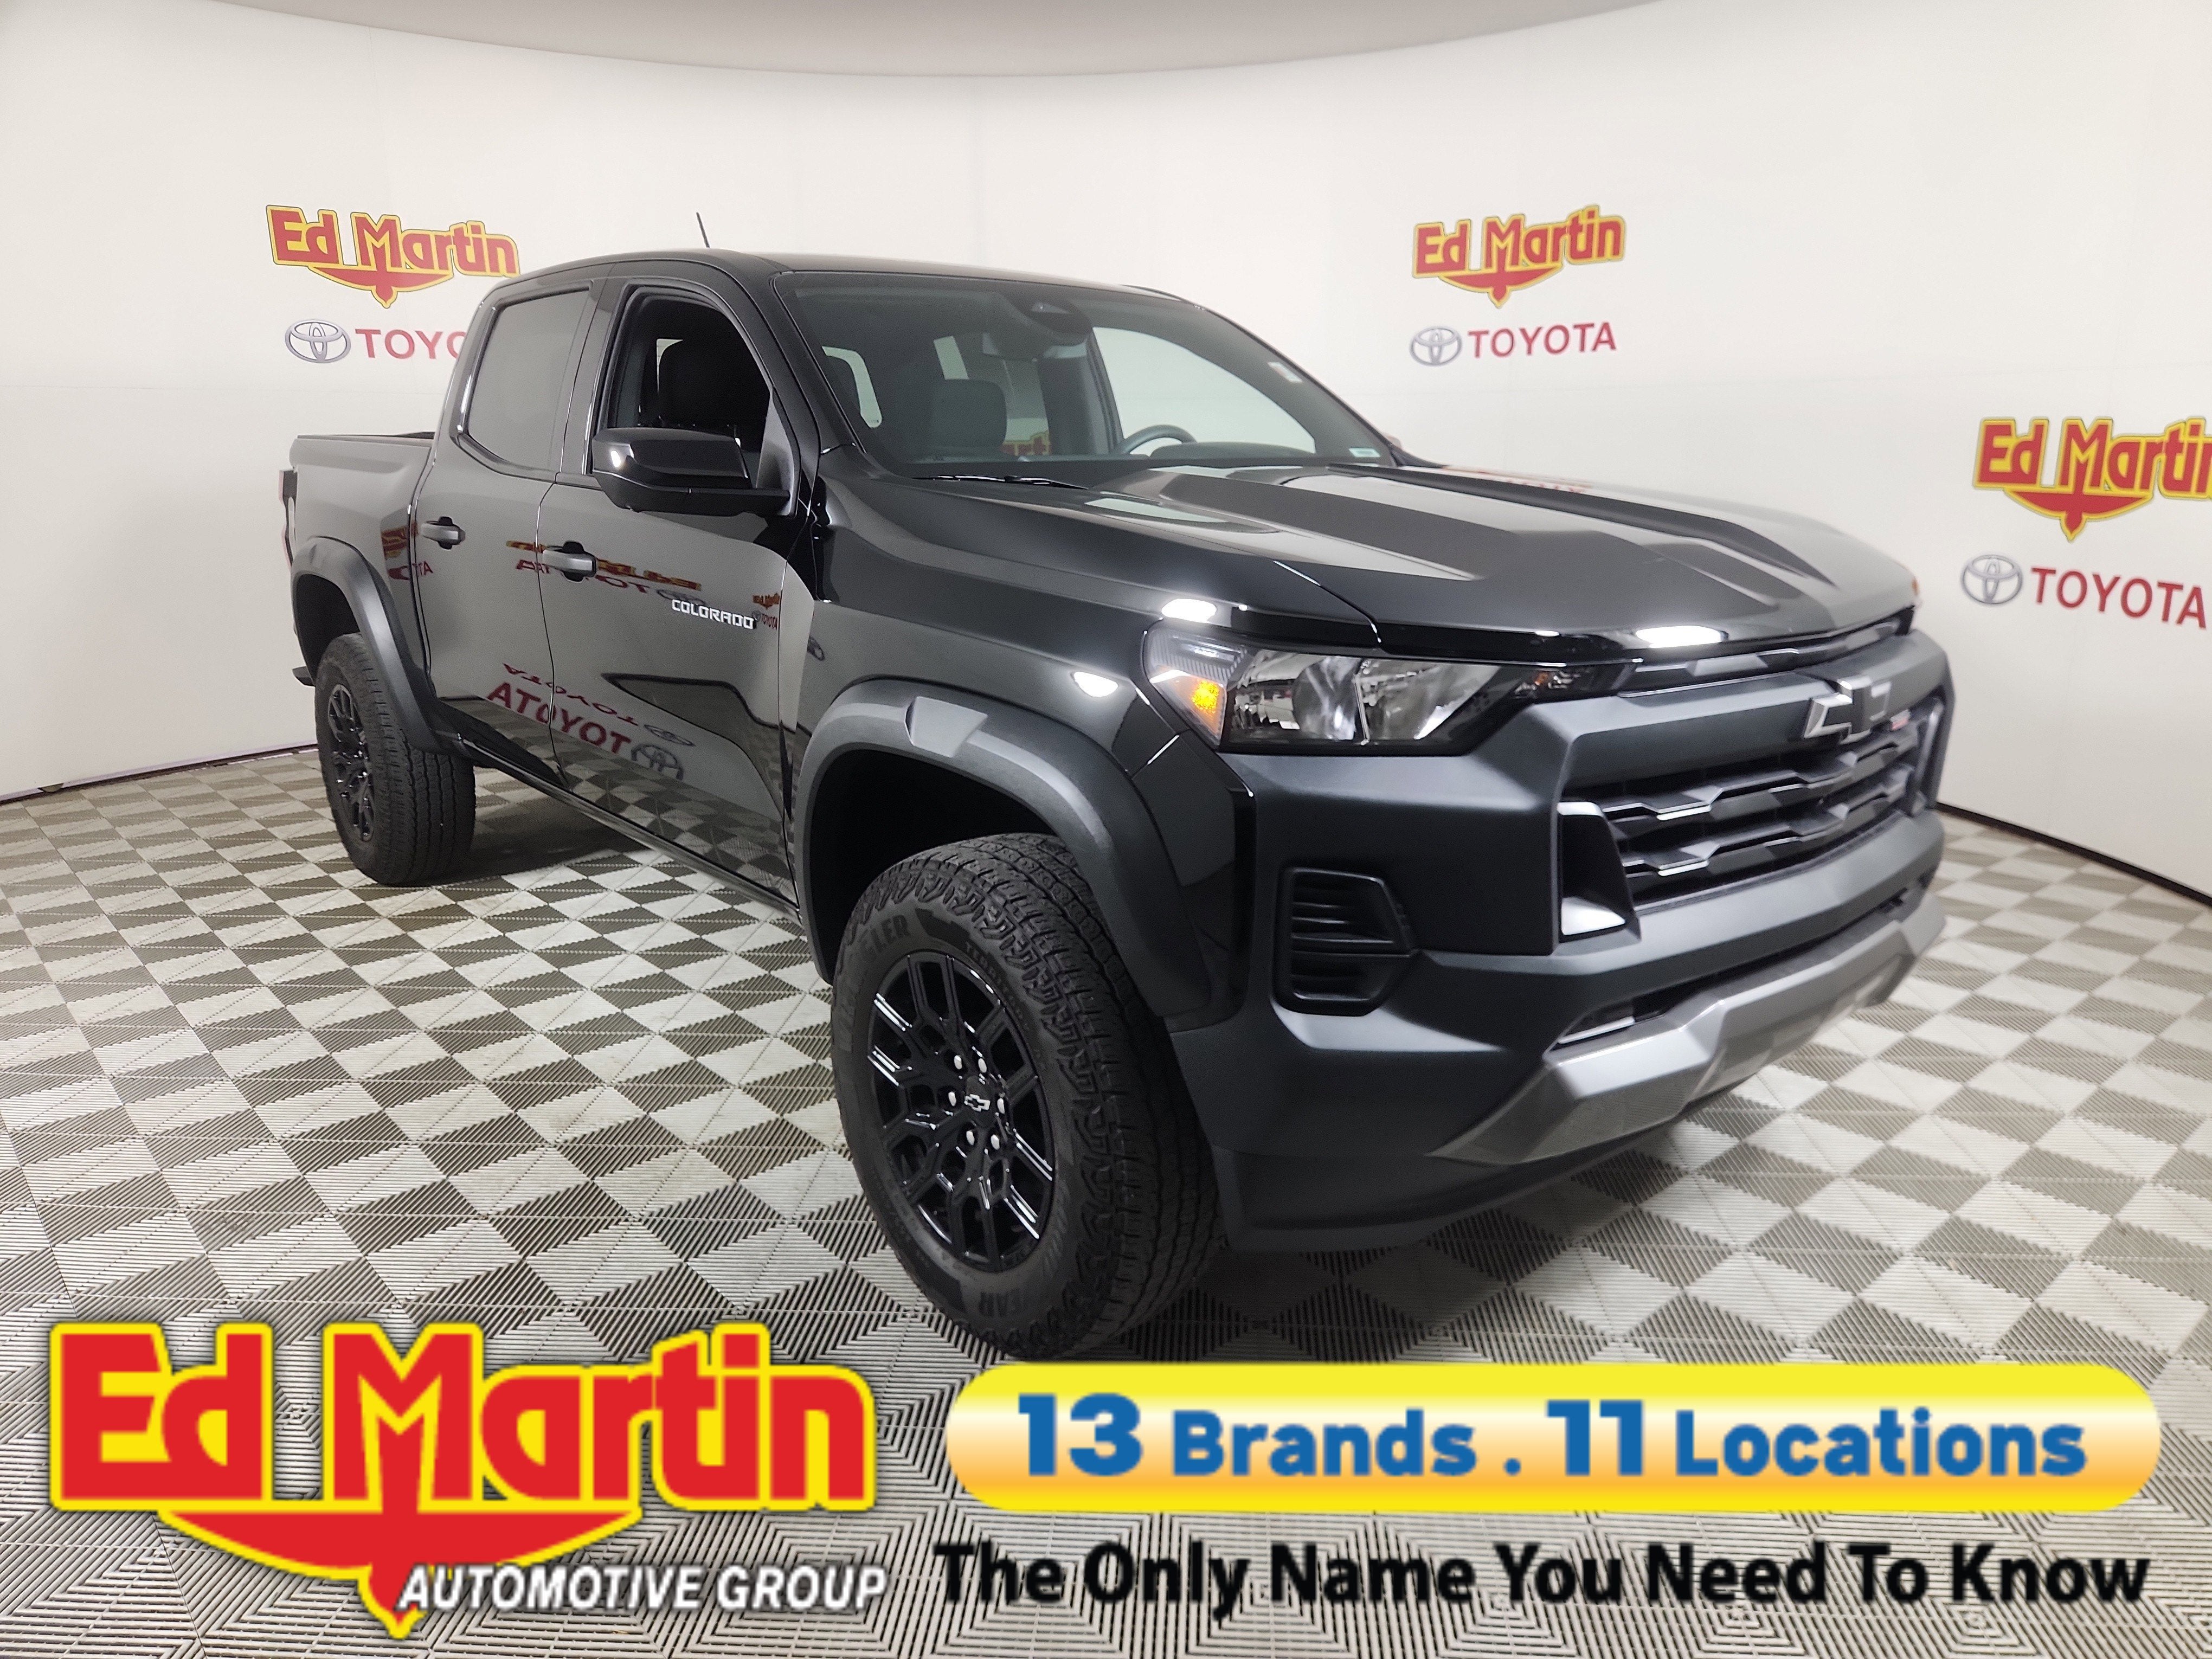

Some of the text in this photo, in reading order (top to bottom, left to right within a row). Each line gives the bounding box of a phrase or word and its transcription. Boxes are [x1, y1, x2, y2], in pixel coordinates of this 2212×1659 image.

[267, 206, 519, 276] Ed Martin
[1413, 205, 1625, 276] Ed Martin
[355, 328, 467, 359] TOYO
[1468, 323, 1617, 358] TOYOTA
[1973, 419, 2048, 488] Ed
[672, 599, 754, 629] COLORADO
[2031, 567, 2207, 629] TOYOTA
